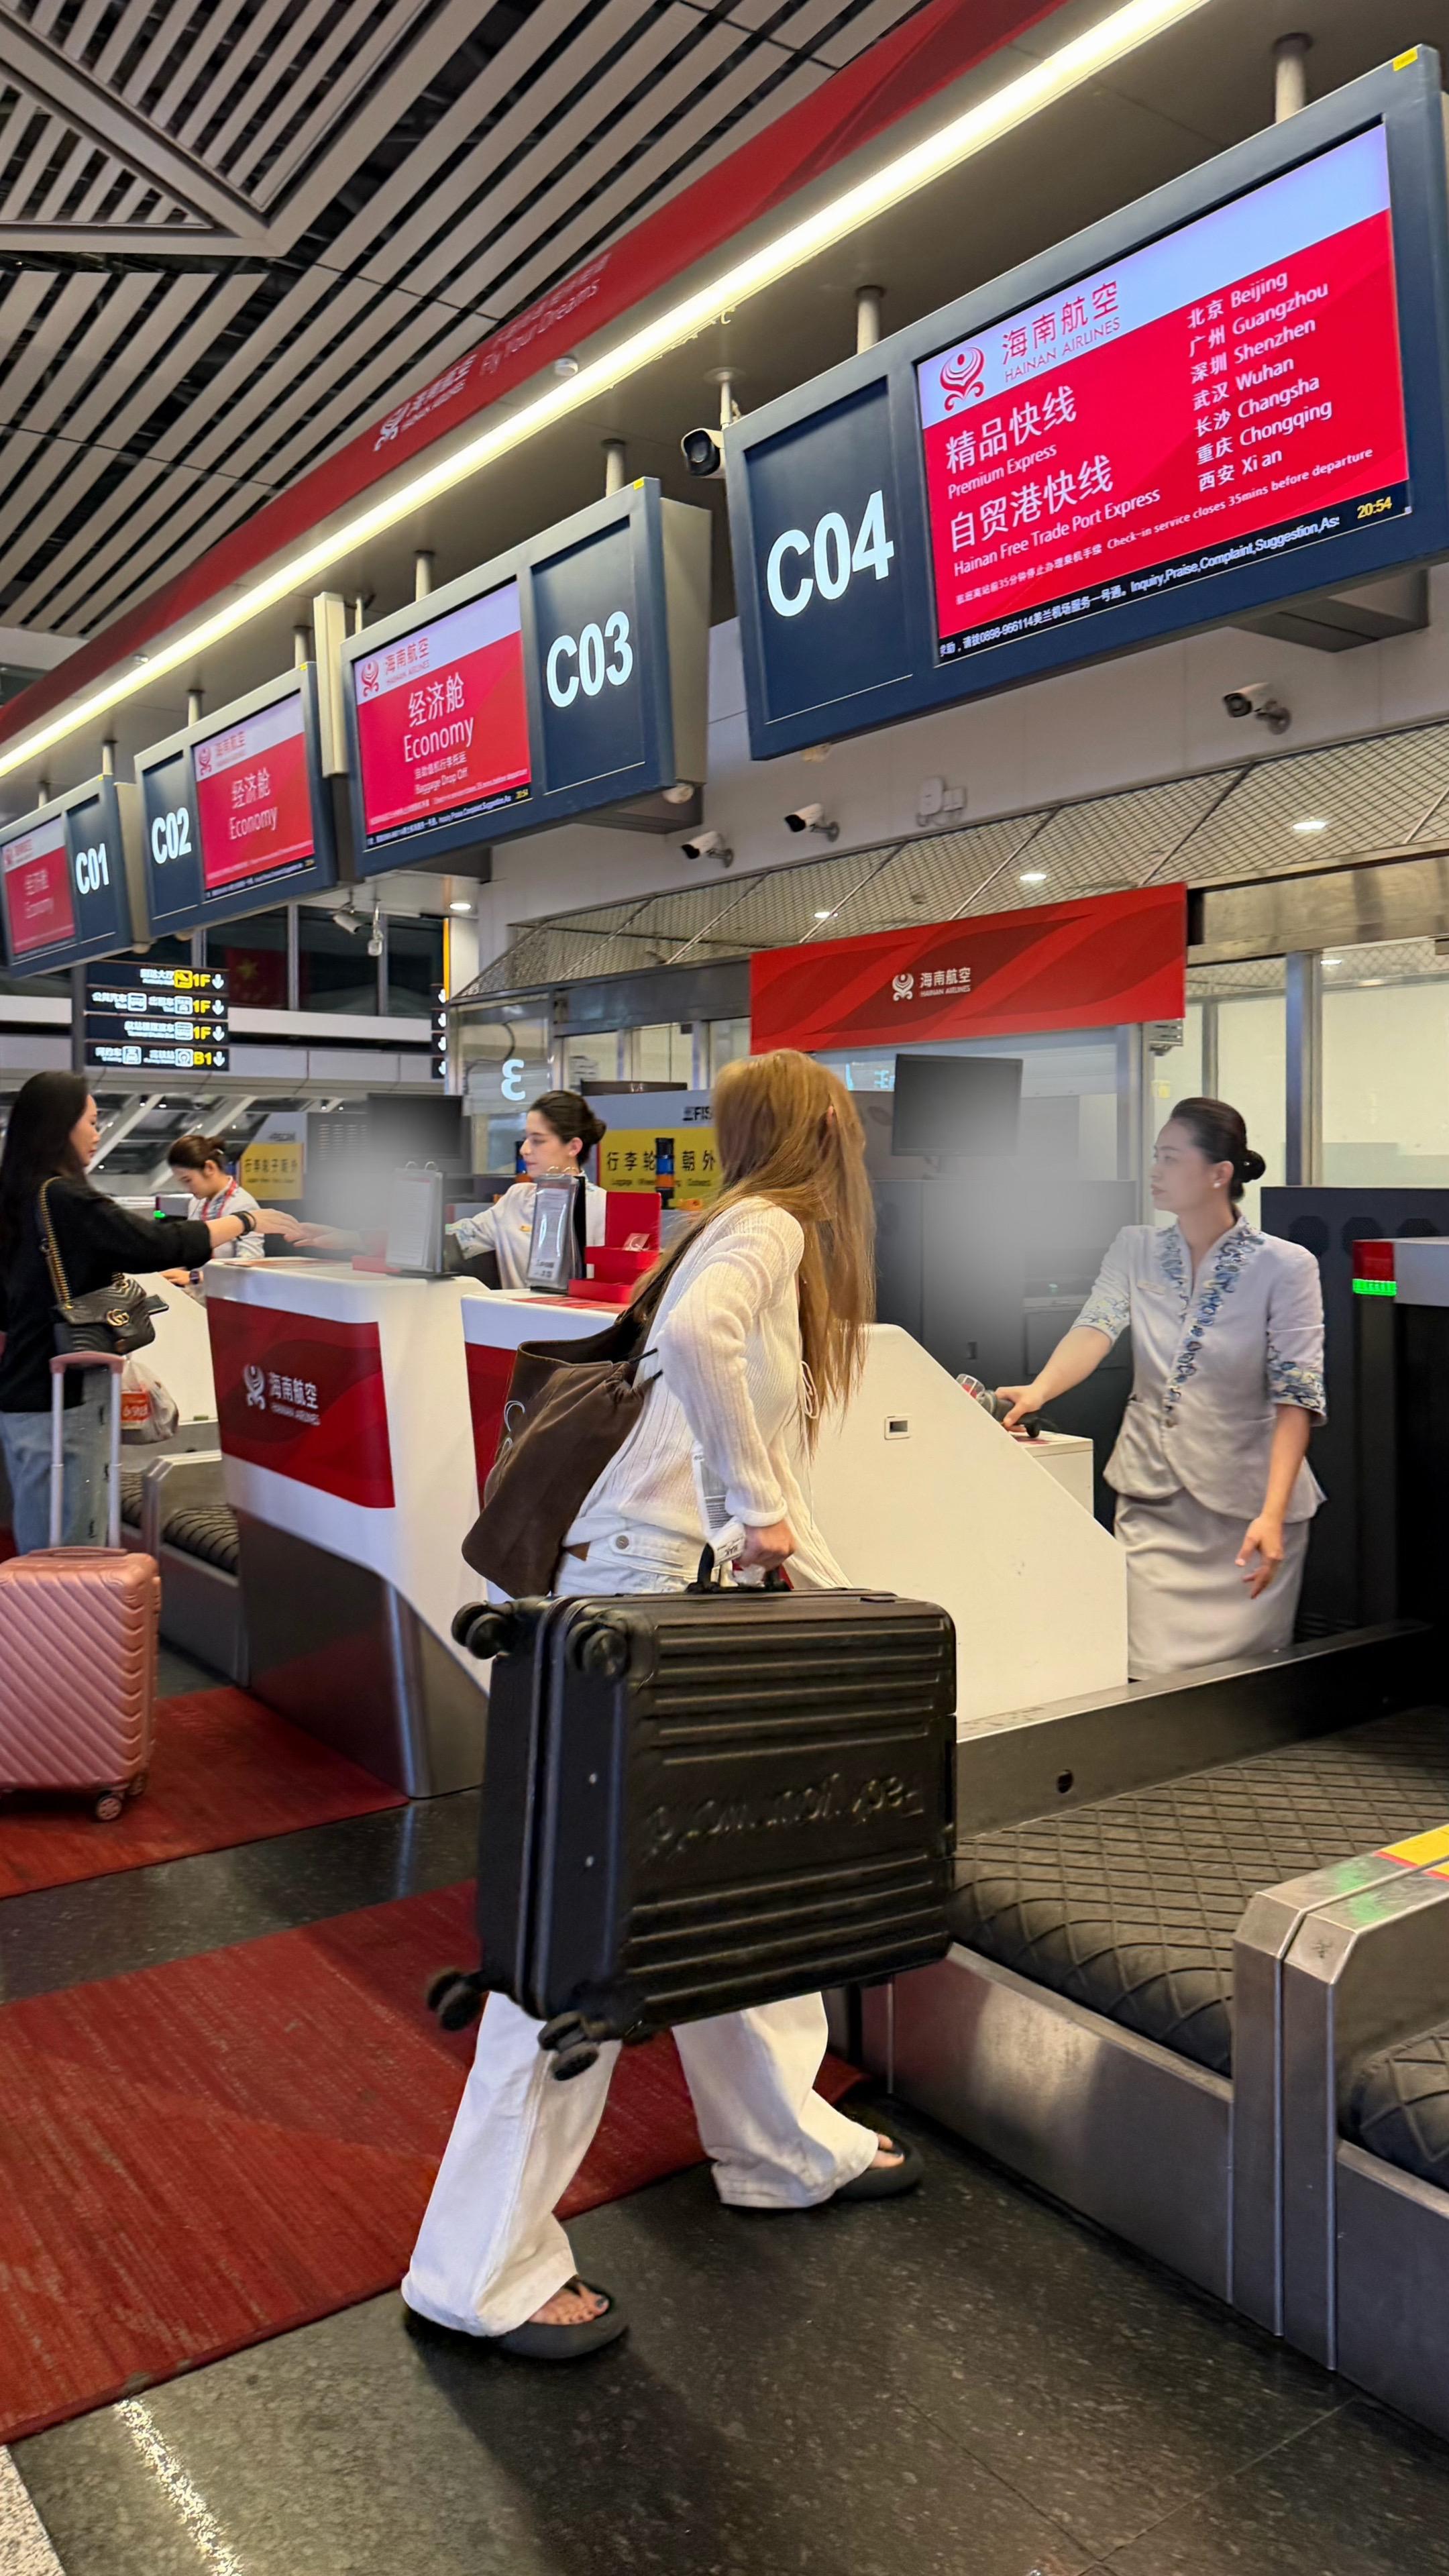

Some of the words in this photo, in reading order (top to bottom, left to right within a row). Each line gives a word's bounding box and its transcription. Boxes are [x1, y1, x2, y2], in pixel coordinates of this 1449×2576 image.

[1002, 280, 1119, 366] 海南航空
[1187, 299, 1224, 329] 北京
[1230, 271, 1288, 309] Beijing
[1189, 325, 1226, 358] 广州
[1232, 282, 1329, 335] Guangzhou
[1005, 347, 1057, 382] HAINAN
[1062, 317, 1120, 356] AIRLINES
[1190, 352, 1228, 384] 深圳
[1234, 317, 1316, 364] Shenzhen
[1192, 382, 1230, 411] 武汉
[1236, 357, 1294, 391] Wuhan
[1194, 408, 1232, 438] 长沙
[1238, 376, 1320, 419] Changsha
[945, 385, 1077, 474] 精品快线
[1196, 436, 1234, 466] 重庆
[1240, 400, 1333, 447] Chongqing
[948, 467, 1005, 500] Premium
[1007, 444, 1058, 475] Express
[1107, 527, 1152, 549] Check-in
[1154, 514, 1191, 533] service
[1192, 500, 1226, 519] closes
[1228, 486, 1269, 506] 35mins
[1271, 471, 1309, 492] before
[1311, 448, 1373, 476] departure
[1198, 464, 1235, 493] 西安
[951, 454, 1114, 553] 自贸港快线
[1356, 496, 1393, 519] 20:54
[767, 490, 894, 617] C04
[954, 551, 998, 578] Hainan
[1000, 539, 1029, 559] Free
[1030, 523, 1070, 547] Trade
[1073, 509, 1102, 533] Port
[1104, 488, 1161, 520] Express
[546, 610, 633, 708] C03
[408, 672, 465, 728] 经济舱
[403, 716, 474, 763] Economy
[152, 807, 192, 865] C02
[229, 806, 279, 840] Economy
[75, 843, 109, 894] C01
[193, 974, 211, 987] 1F
[920, 967, 971, 988] 海南航空
[193, 1000, 211, 1014] 1F
[193, 1026, 211, 1040] 1F
[193, 1052, 212, 1065] B1
[606, 1149, 716, 1171] 行李轮朝外
